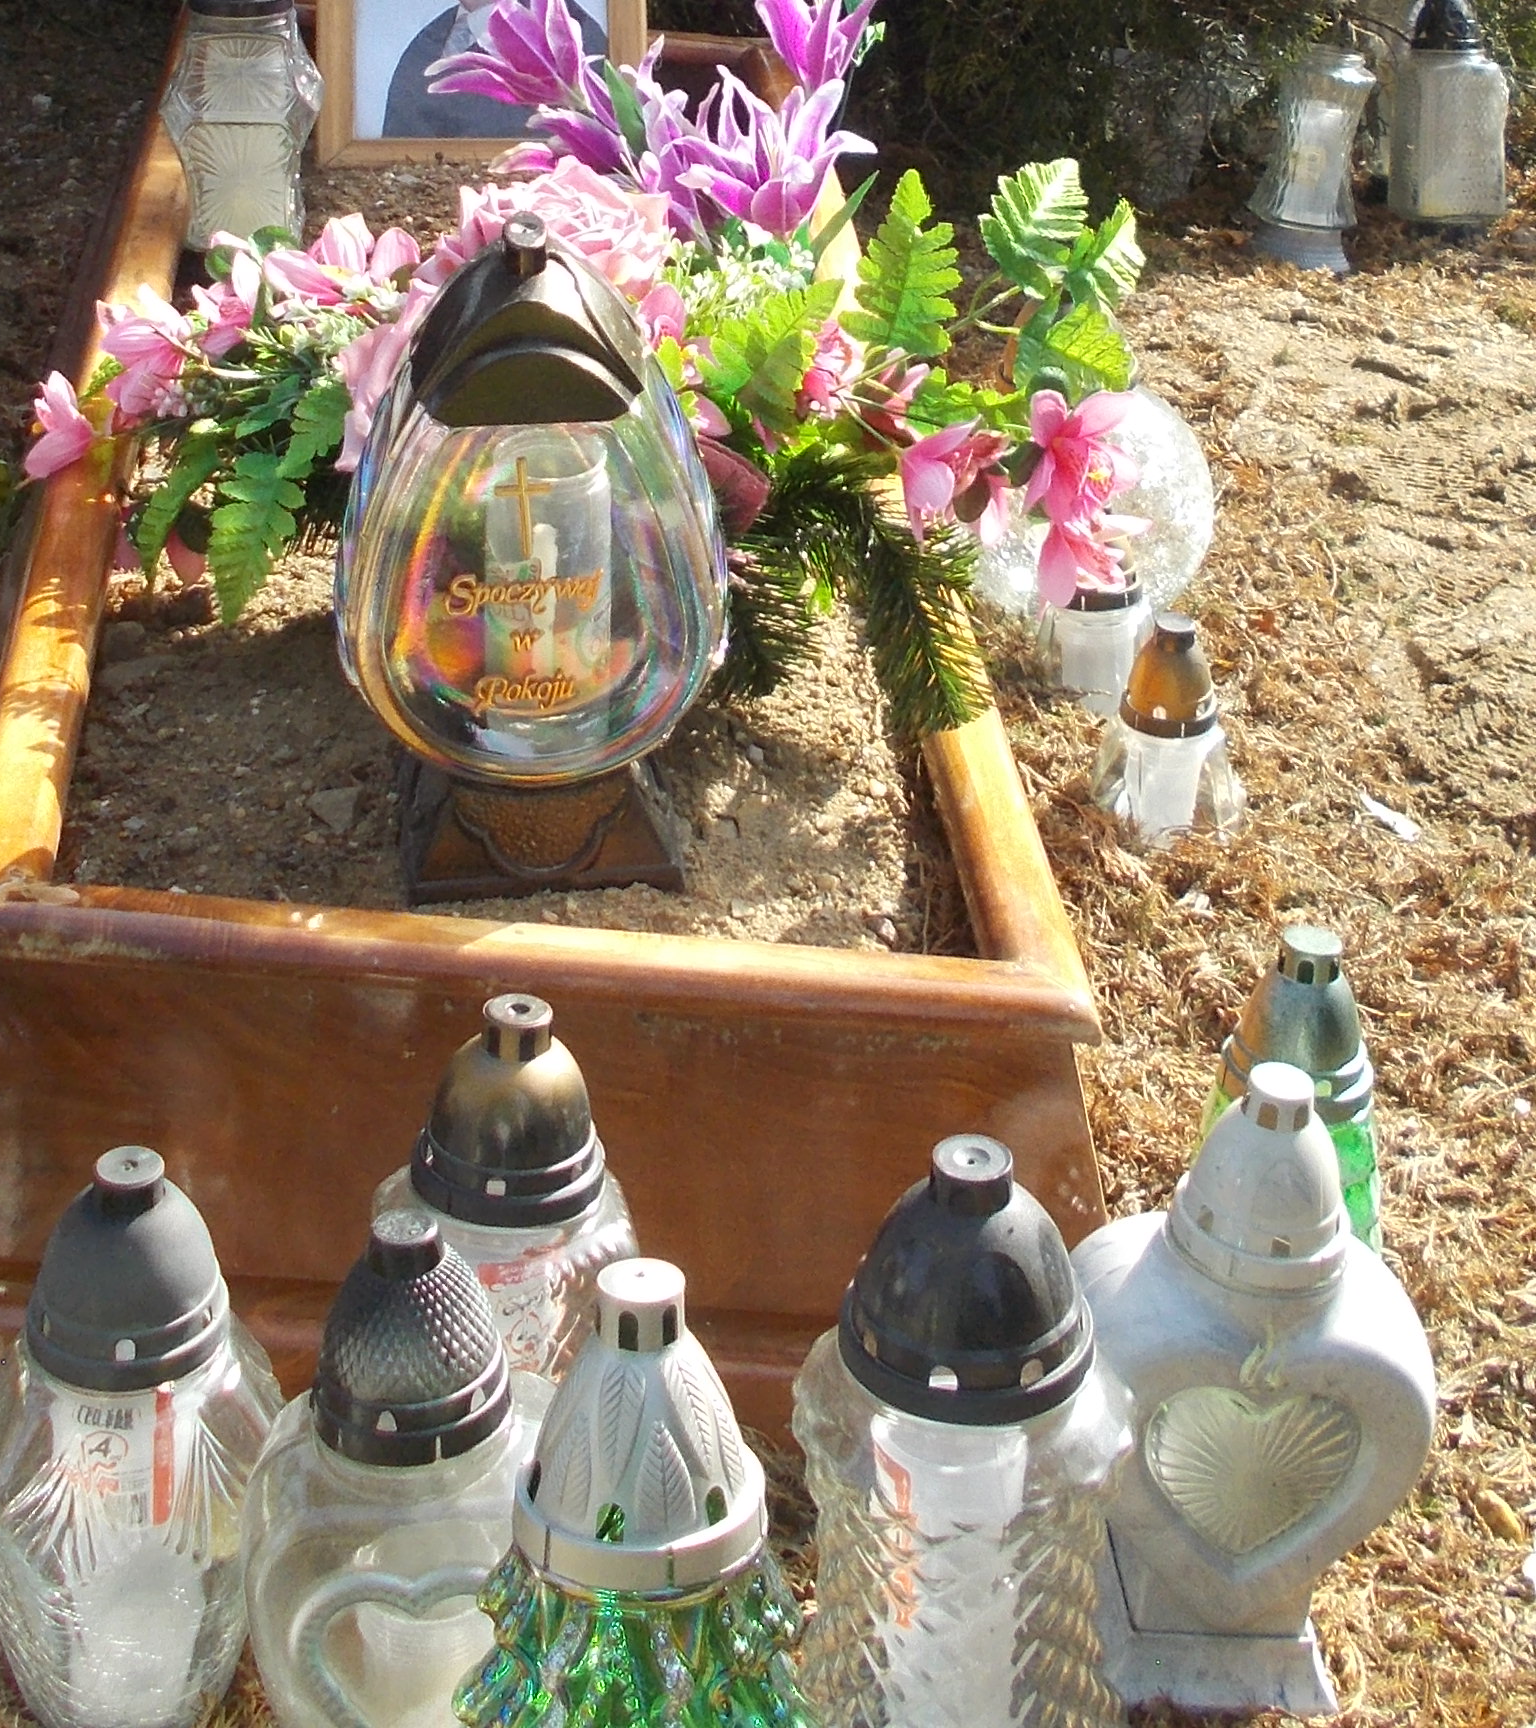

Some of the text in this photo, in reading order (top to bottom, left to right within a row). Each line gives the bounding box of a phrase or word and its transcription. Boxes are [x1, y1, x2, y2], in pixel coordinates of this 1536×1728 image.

[443, 569, 604, 617] Spoczywaj
[509, 628, 545, 652] w
[476, 672, 575, 709] Pokoju
